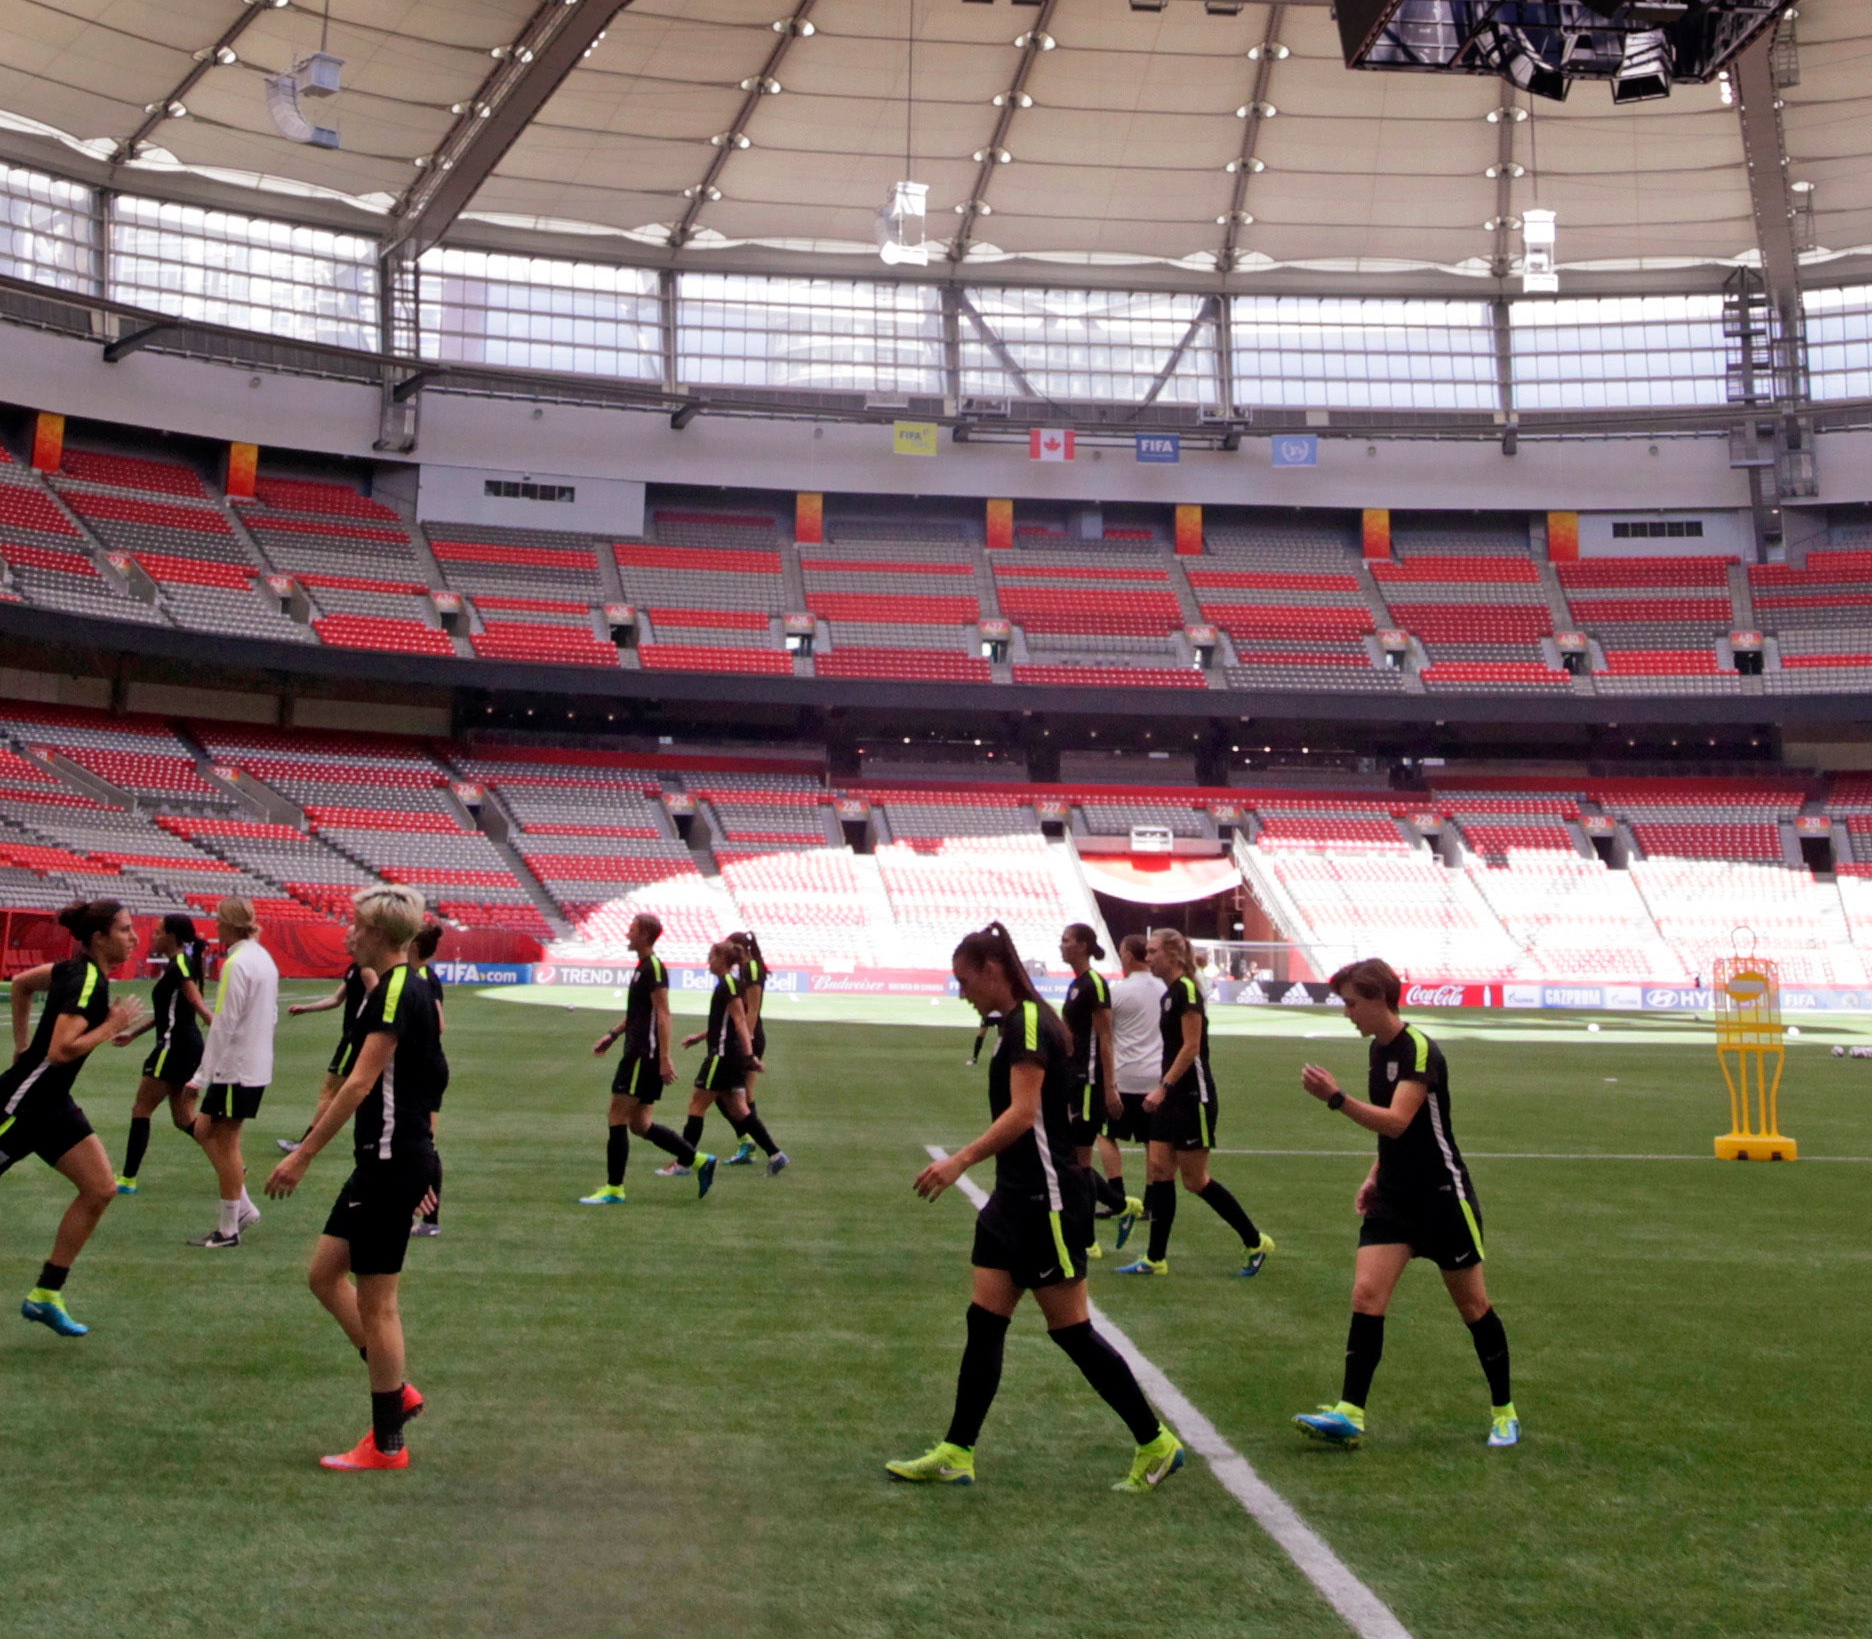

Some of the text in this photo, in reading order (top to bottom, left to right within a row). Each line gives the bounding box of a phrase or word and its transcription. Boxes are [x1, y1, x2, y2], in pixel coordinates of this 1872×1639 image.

[1141, 439, 1173, 452] FIFA
[1042, 802, 1060, 813] 227
[560, 967, 613, 984] TREND
[812, 971, 884, 991] Budweiser
[1544, 988, 1601, 1005] GAZPROM
[1785, 994, 1816, 1007] FIFA
